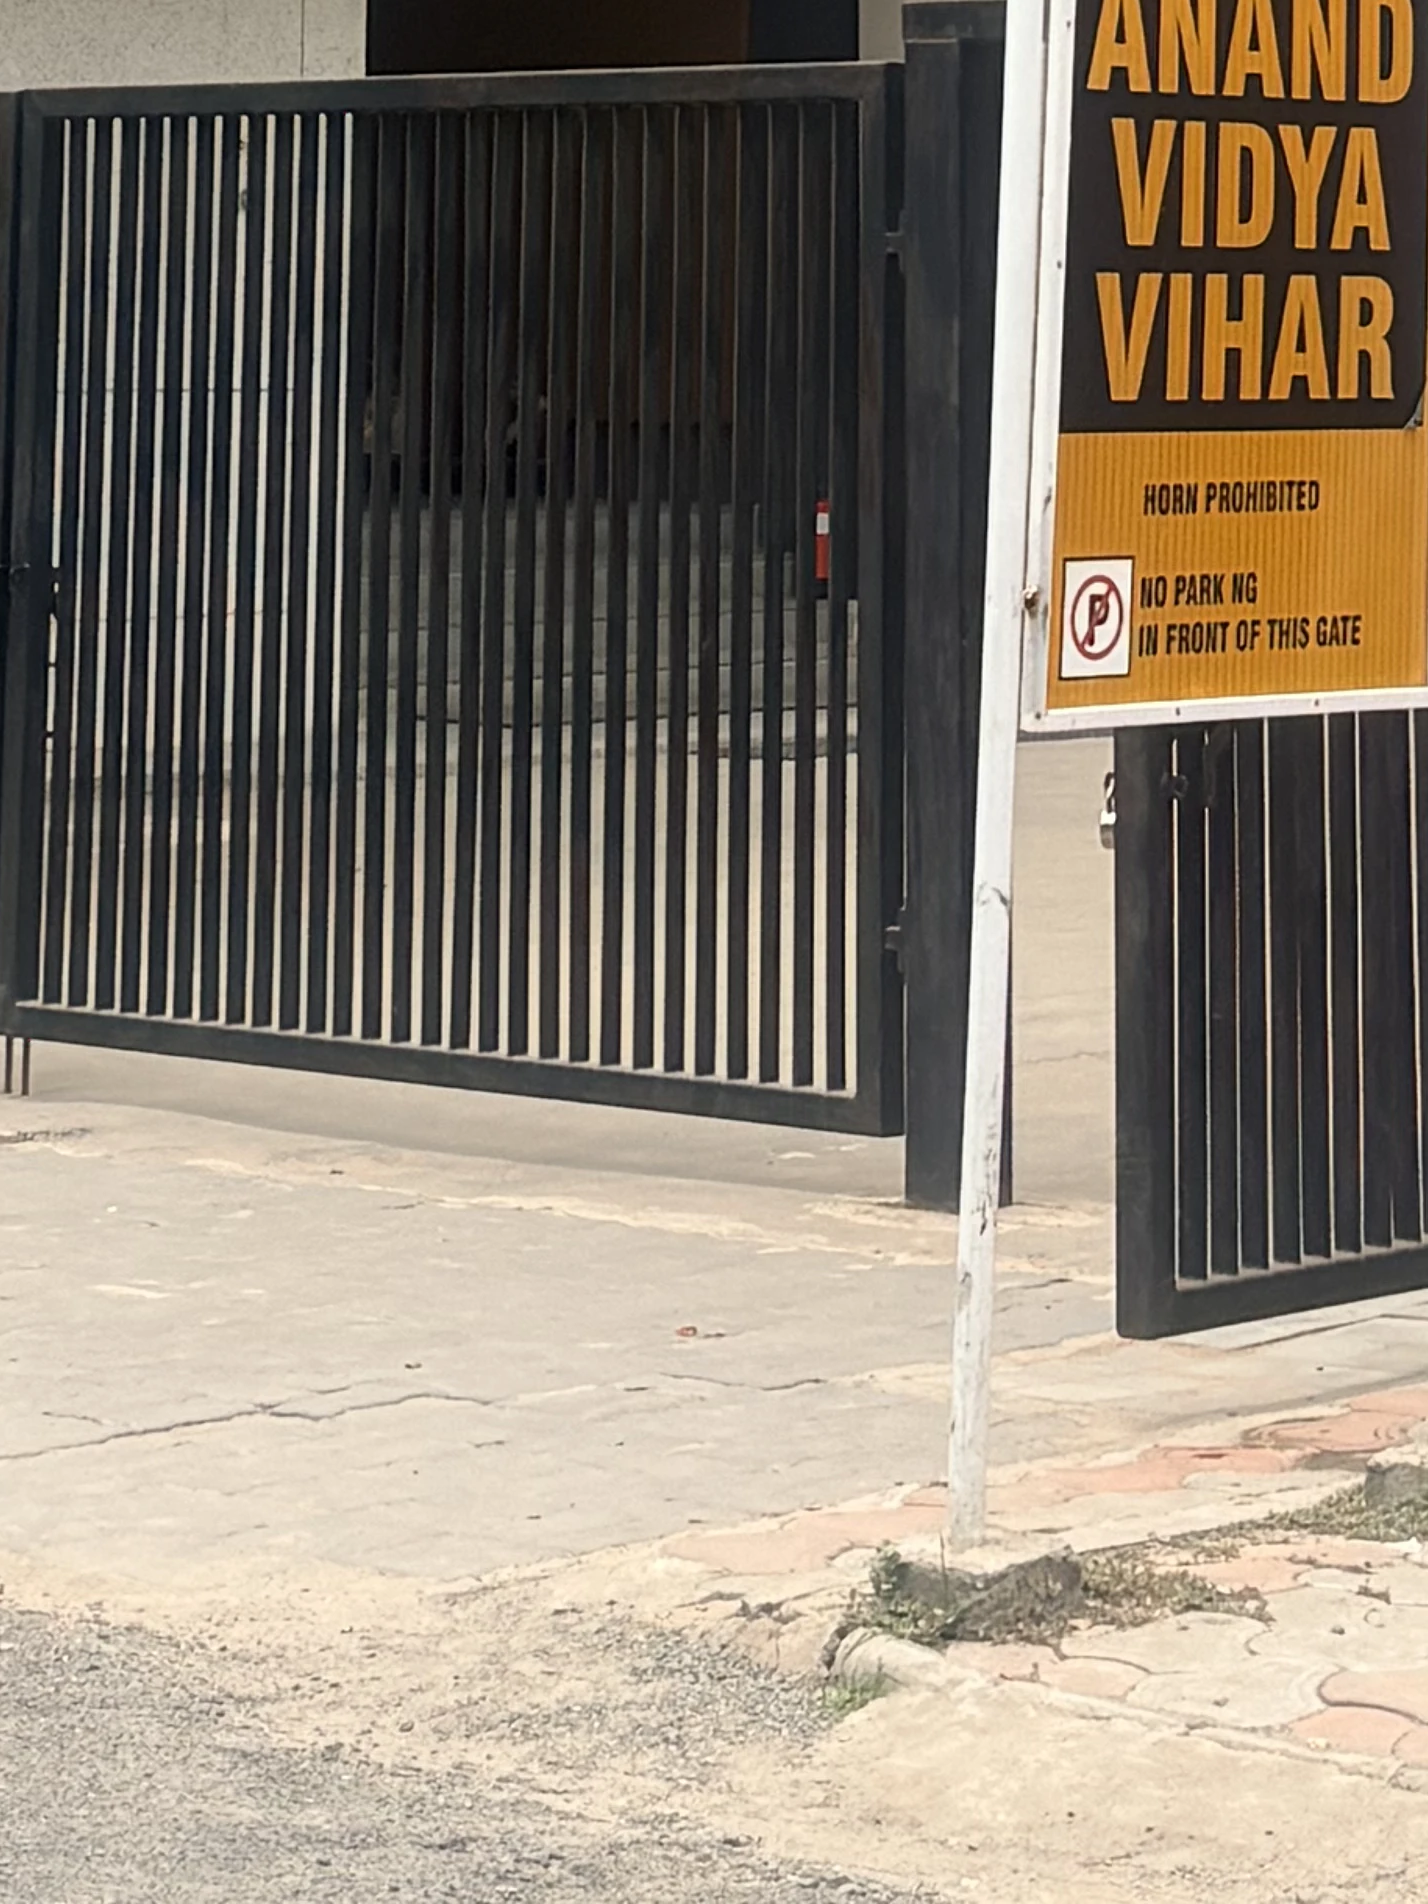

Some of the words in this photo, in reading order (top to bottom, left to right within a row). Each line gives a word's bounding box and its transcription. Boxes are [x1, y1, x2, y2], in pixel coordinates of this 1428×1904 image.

[1110, 117, 1391, 251] VIDYA
[1095, 272, 1395, 402] VIHAR
[1143, 482, 1199, 516] HORN
[1204, 479, 1321, 514] PROHIBITED
[1140, 576, 1167, 609] NO
[1138, 624, 1158, 657] IN
[1165, 621, 1230, 656] FRONT
[1235, 618, 1261, 652] OF
[1267, 616, 1310, 651] THIS
[1315, 614, 1363, 647] GATE
